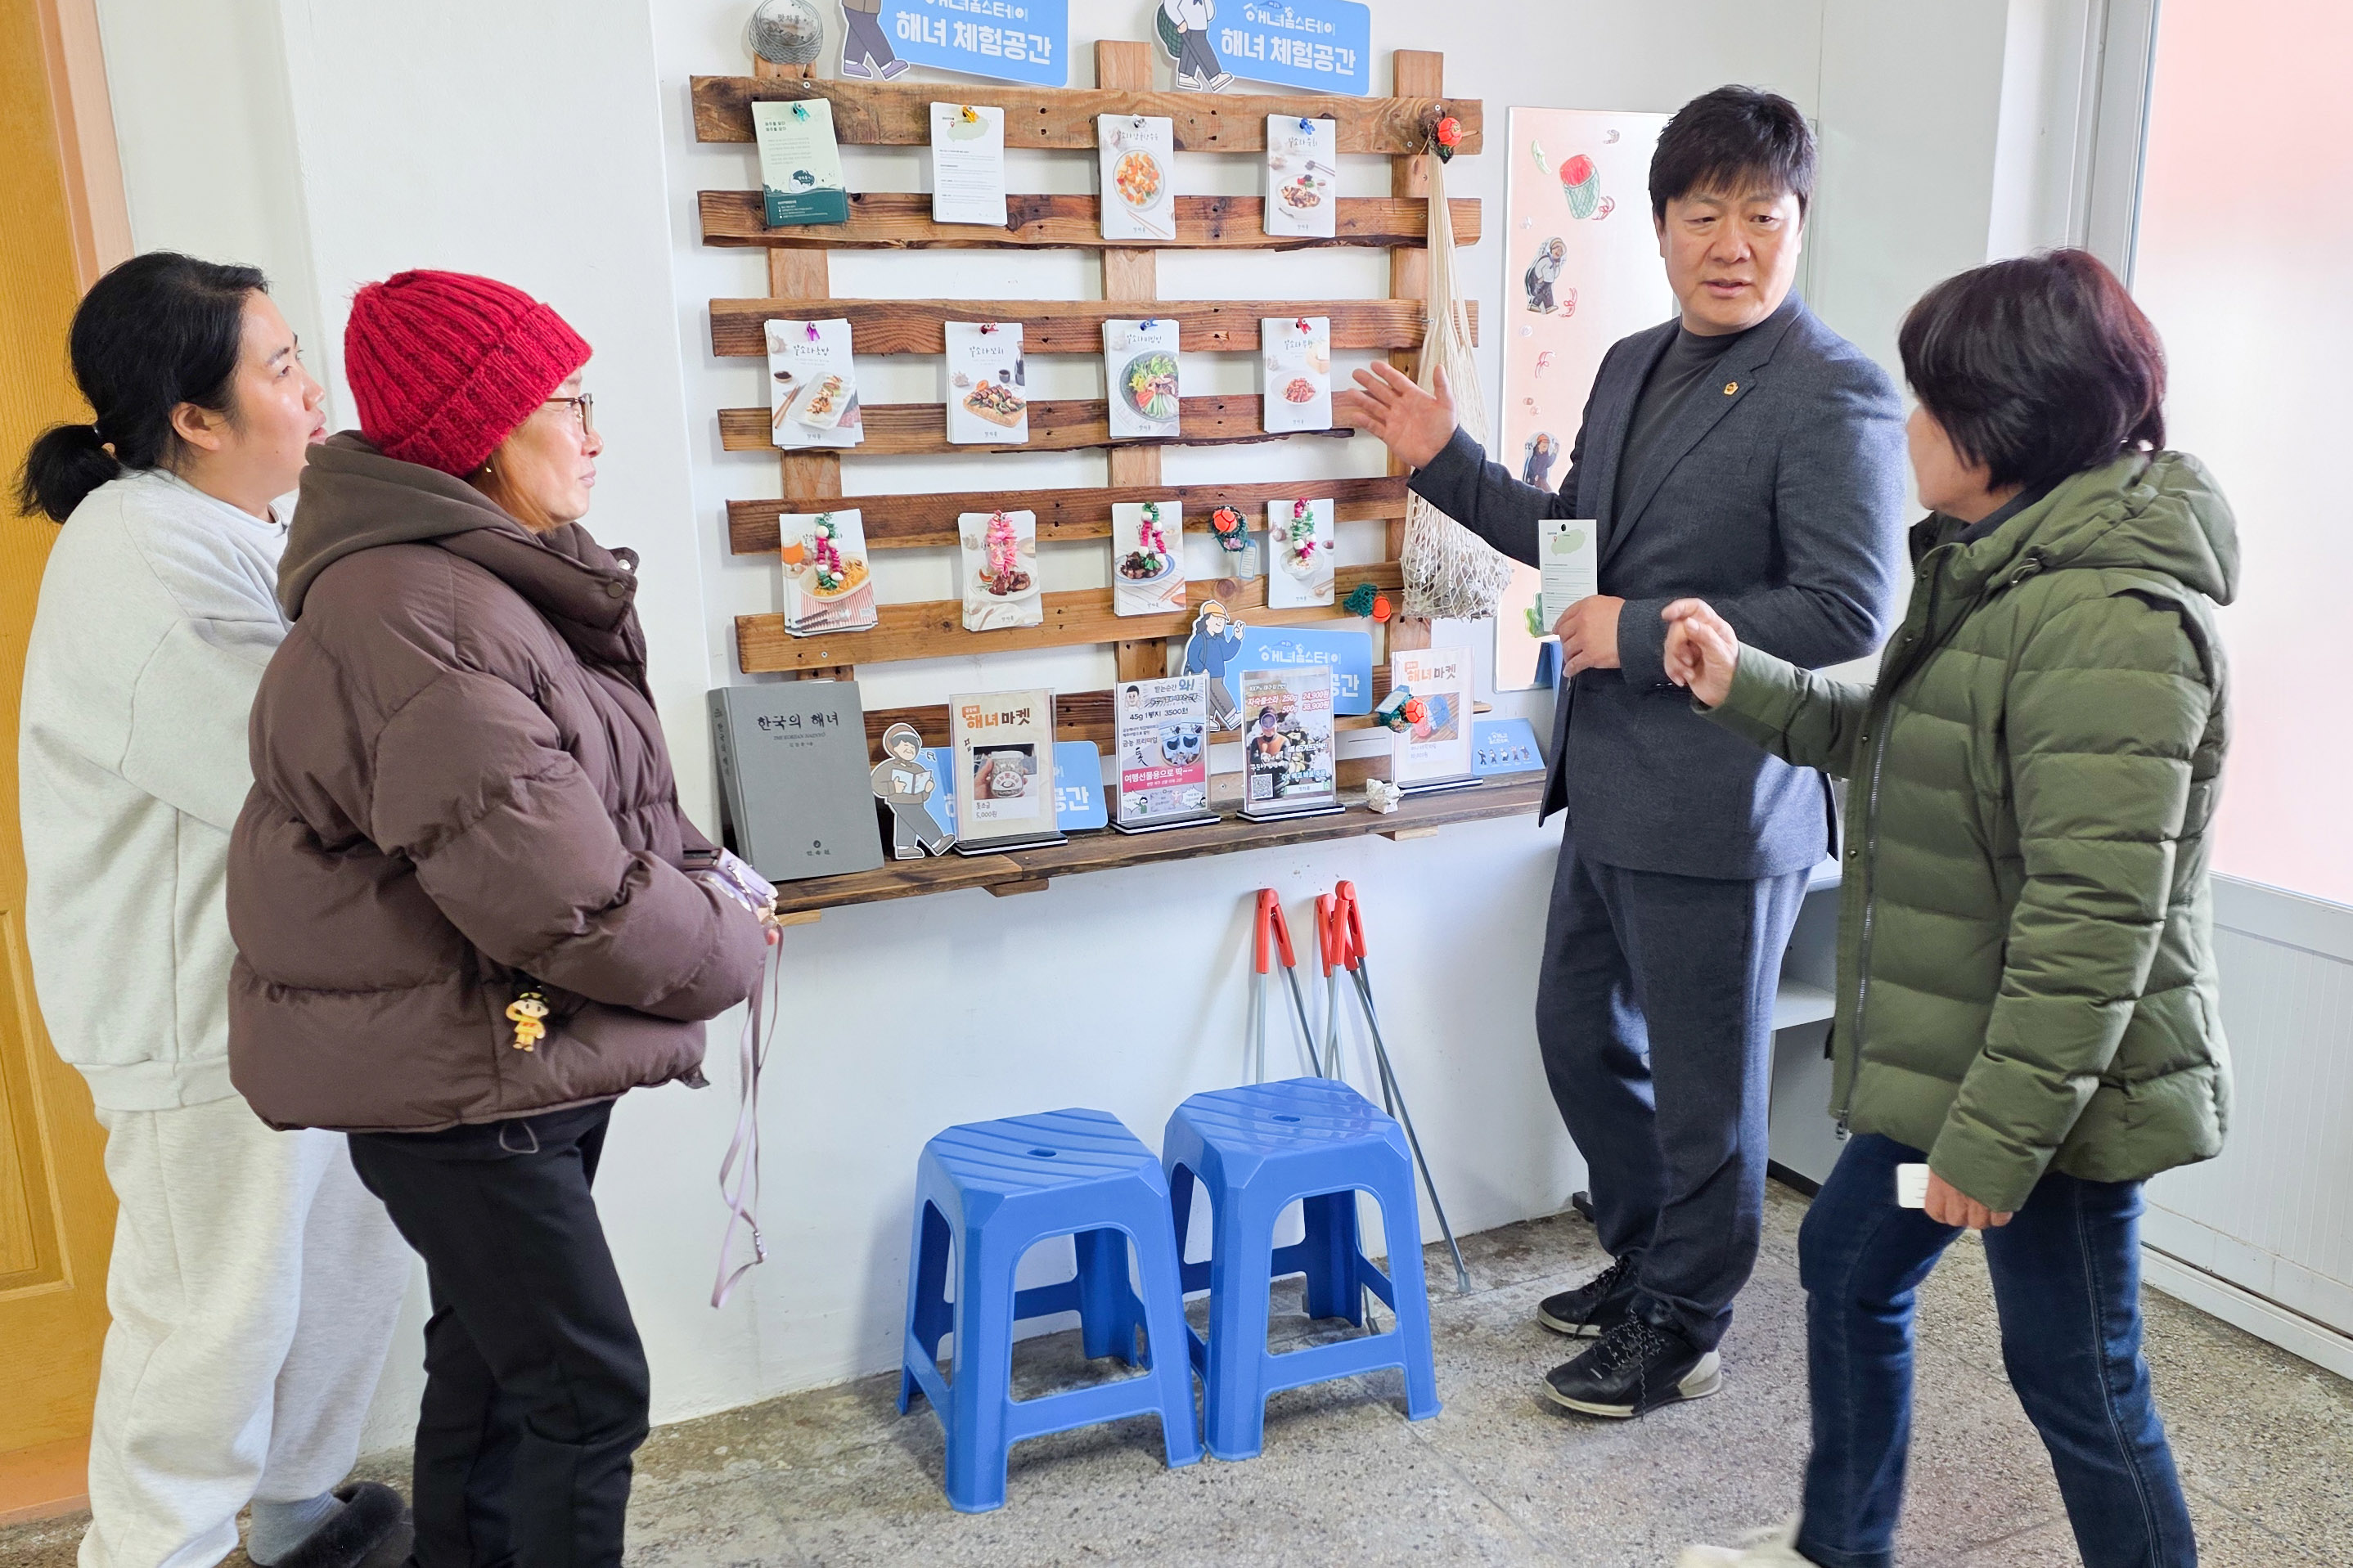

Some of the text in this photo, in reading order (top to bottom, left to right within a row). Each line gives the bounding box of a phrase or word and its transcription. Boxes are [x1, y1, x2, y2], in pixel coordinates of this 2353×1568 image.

[896, 11, 1052, 65] 해녀 체험공간
[1221, 28, 1356, 76] 해녀 체험공간
[1406, 664, 1456, 682] 해녀 마켓
[1179, 678, 1195, 691] 와!
[1282, 694, 1298, 703] 250g
[1129, 713, 1144, 721] 45g
[1164, 707, 1189, 717] 3500원
[1282, 704, 1298, 714] 500g
[757, 711, 839, 731] 한국의 해녀
[966, 708, 1030, 729] 해녀 마켓
[1124, 769, 1174, 784] 여행선물용으로
[976, 811, 997, 819] 5,000원
